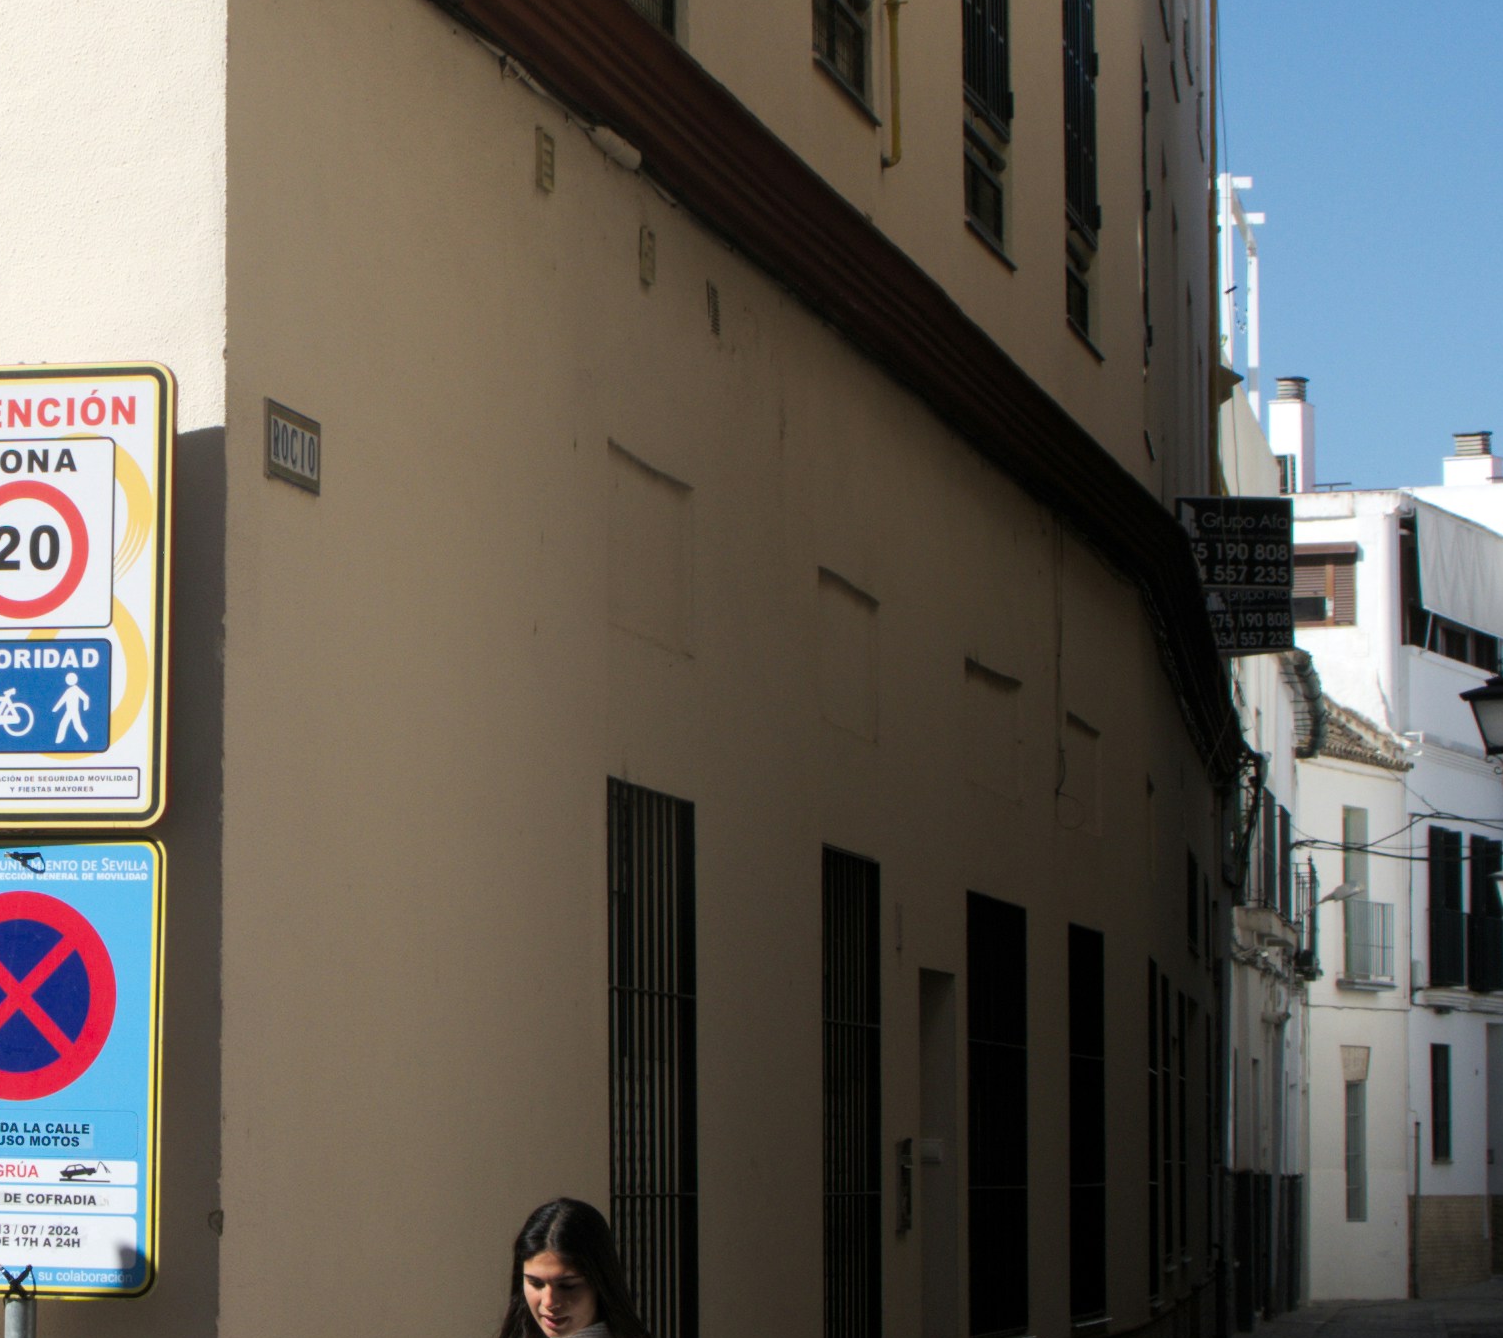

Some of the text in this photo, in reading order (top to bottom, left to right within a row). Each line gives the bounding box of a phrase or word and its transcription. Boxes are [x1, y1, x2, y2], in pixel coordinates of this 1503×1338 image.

[272, 417, 317, 478] ROCIO
[1201, 511, 1288, 531] Grupo Afa
[1215, 542, 1249, 560] 190
[1253, 543, 1289, 561] 808
[1213, 565, 1249, 583] 557
[1253, 565, 1289, 583] 235
[87, 774, 134, 782] MOVILIDAD
[81, 859, 98, 871] DE
[101, 857, 148, 872] SEVILLA
[36, 872, 79, 881] GENERAL
[81, 872, 93, 881] DE
[96, 872, 148, 881] MOVILIDAD
[23, 1122, 42, 1133] LA
[45, 1123, 90, 1134] CALLE
[29, 1135, 80, 1147] MOTOS
[3, 1192, 21, 1204] DE
[25, 1193, 97, 1206] COFRADIA
[21, 1224, 37, 1235] 07
[47, 1225, 79, 1236] 2024
[14, 1237, 39, 1247] 17H
[42, 1237, 52, 1247] A
[55, 1237, 81, 1248] 24H
[38, 1271, 53, 1281] su
[56, 1269, 134, 1283] colaboración
